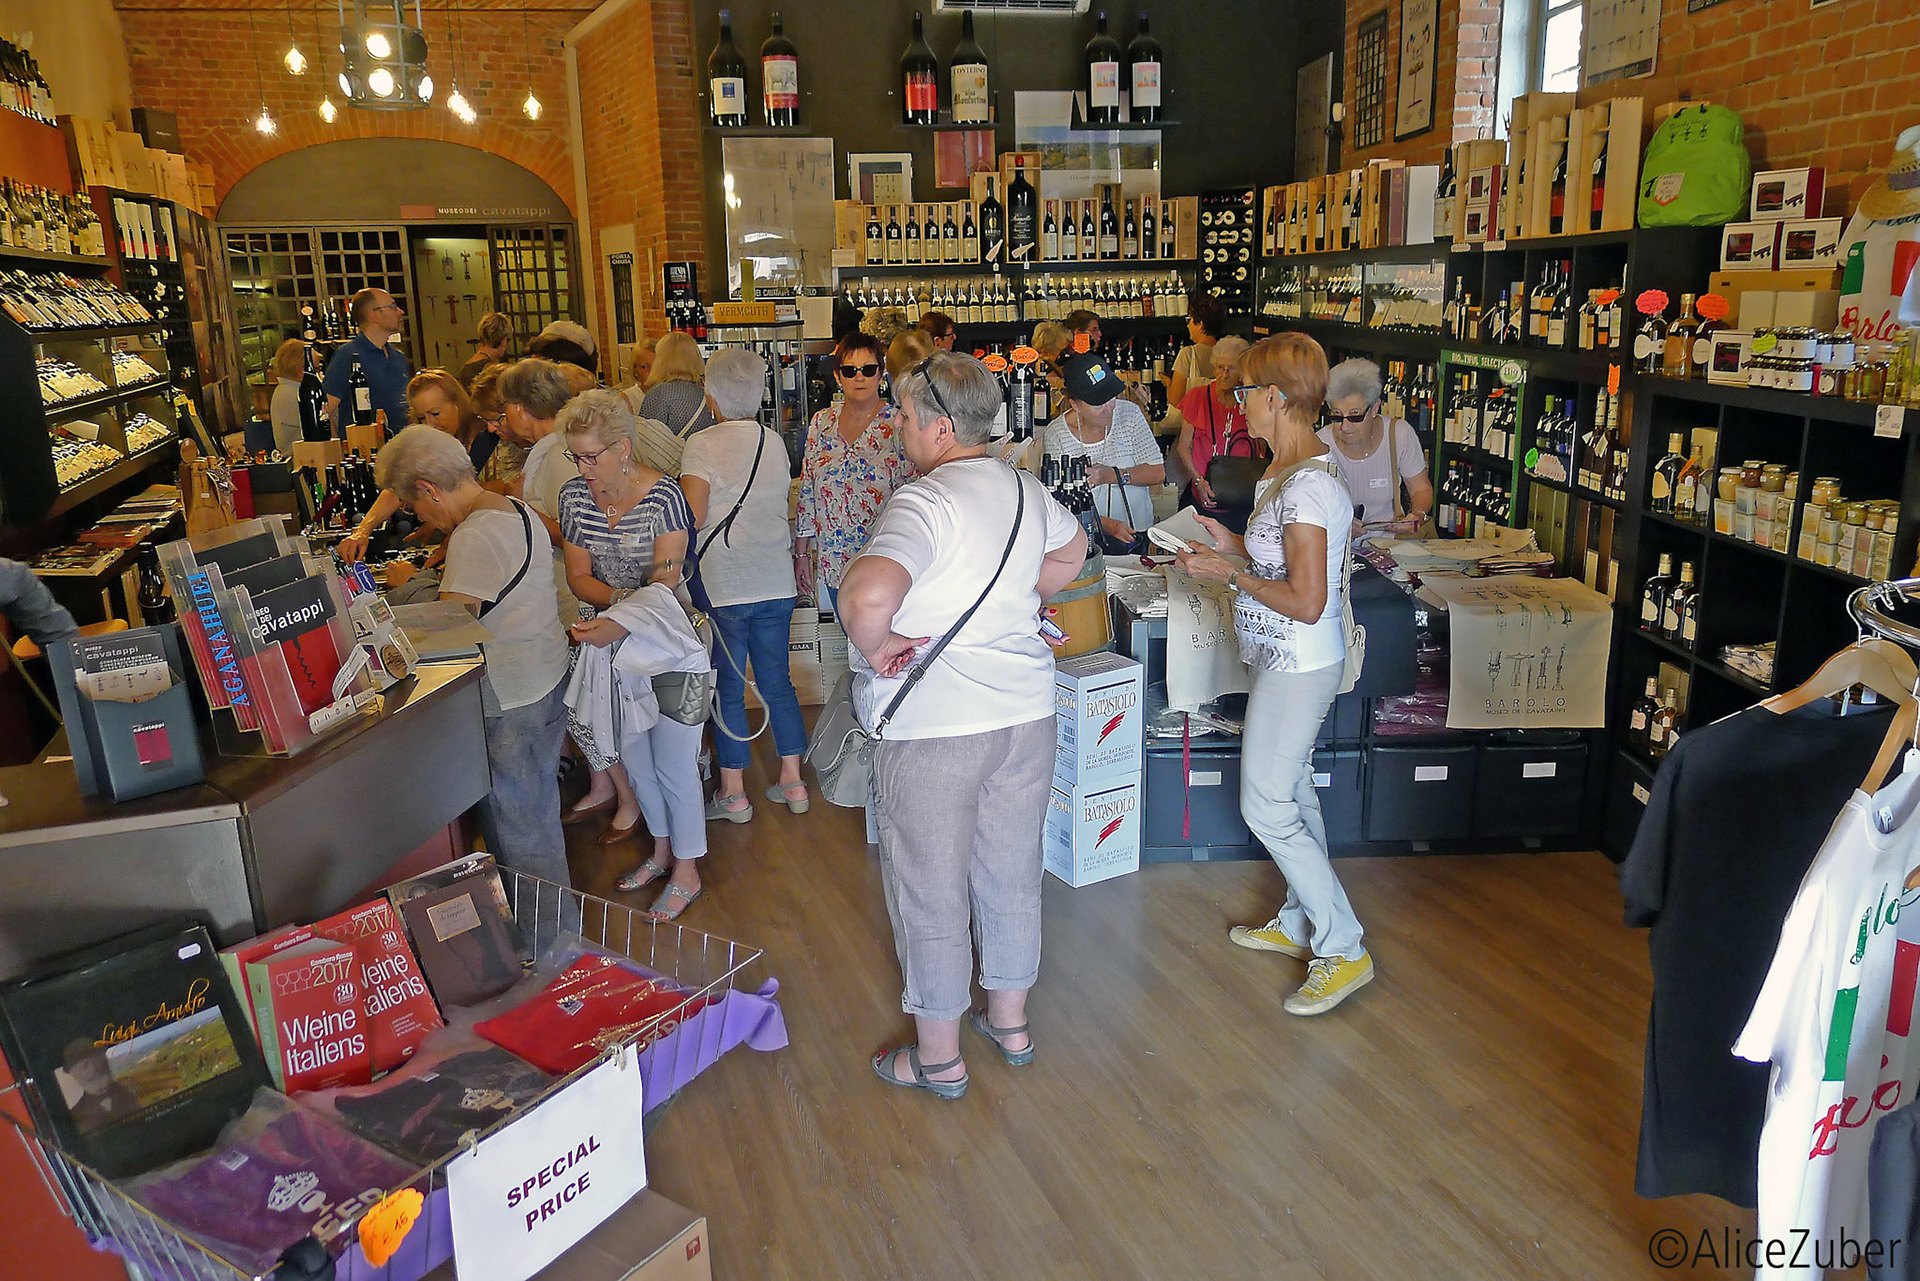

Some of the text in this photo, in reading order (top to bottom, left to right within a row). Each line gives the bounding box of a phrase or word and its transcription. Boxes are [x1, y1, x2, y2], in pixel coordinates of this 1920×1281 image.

[482, 206, 551, 218] cavatappi
[718, 305, 769, 317] VERMOUTH
[252, 599, 324, 639] cavatappi
[260, 614, 273, 623] DEI
[86, 646, 139, 660] cavatappi
[1086, 691, 1137, 718] BATASIOLO
[1485, 698, 1566, 708] BAROLO
[1084, 796, 1136, 822] BATASIOLO
[355, 908, 390, 938] 2017
[381, 932, 398, 946] 30
[311, 957, 354, 987] 2017
[337, 982, 354, 998] 30
[282, 1008, 357, 1047] Weine
[285, 1033, 366, 1076] Italiens
[506, 1134, 601, 1209] SPECIAL
[525, 1170, 592, 1233] PRICE
